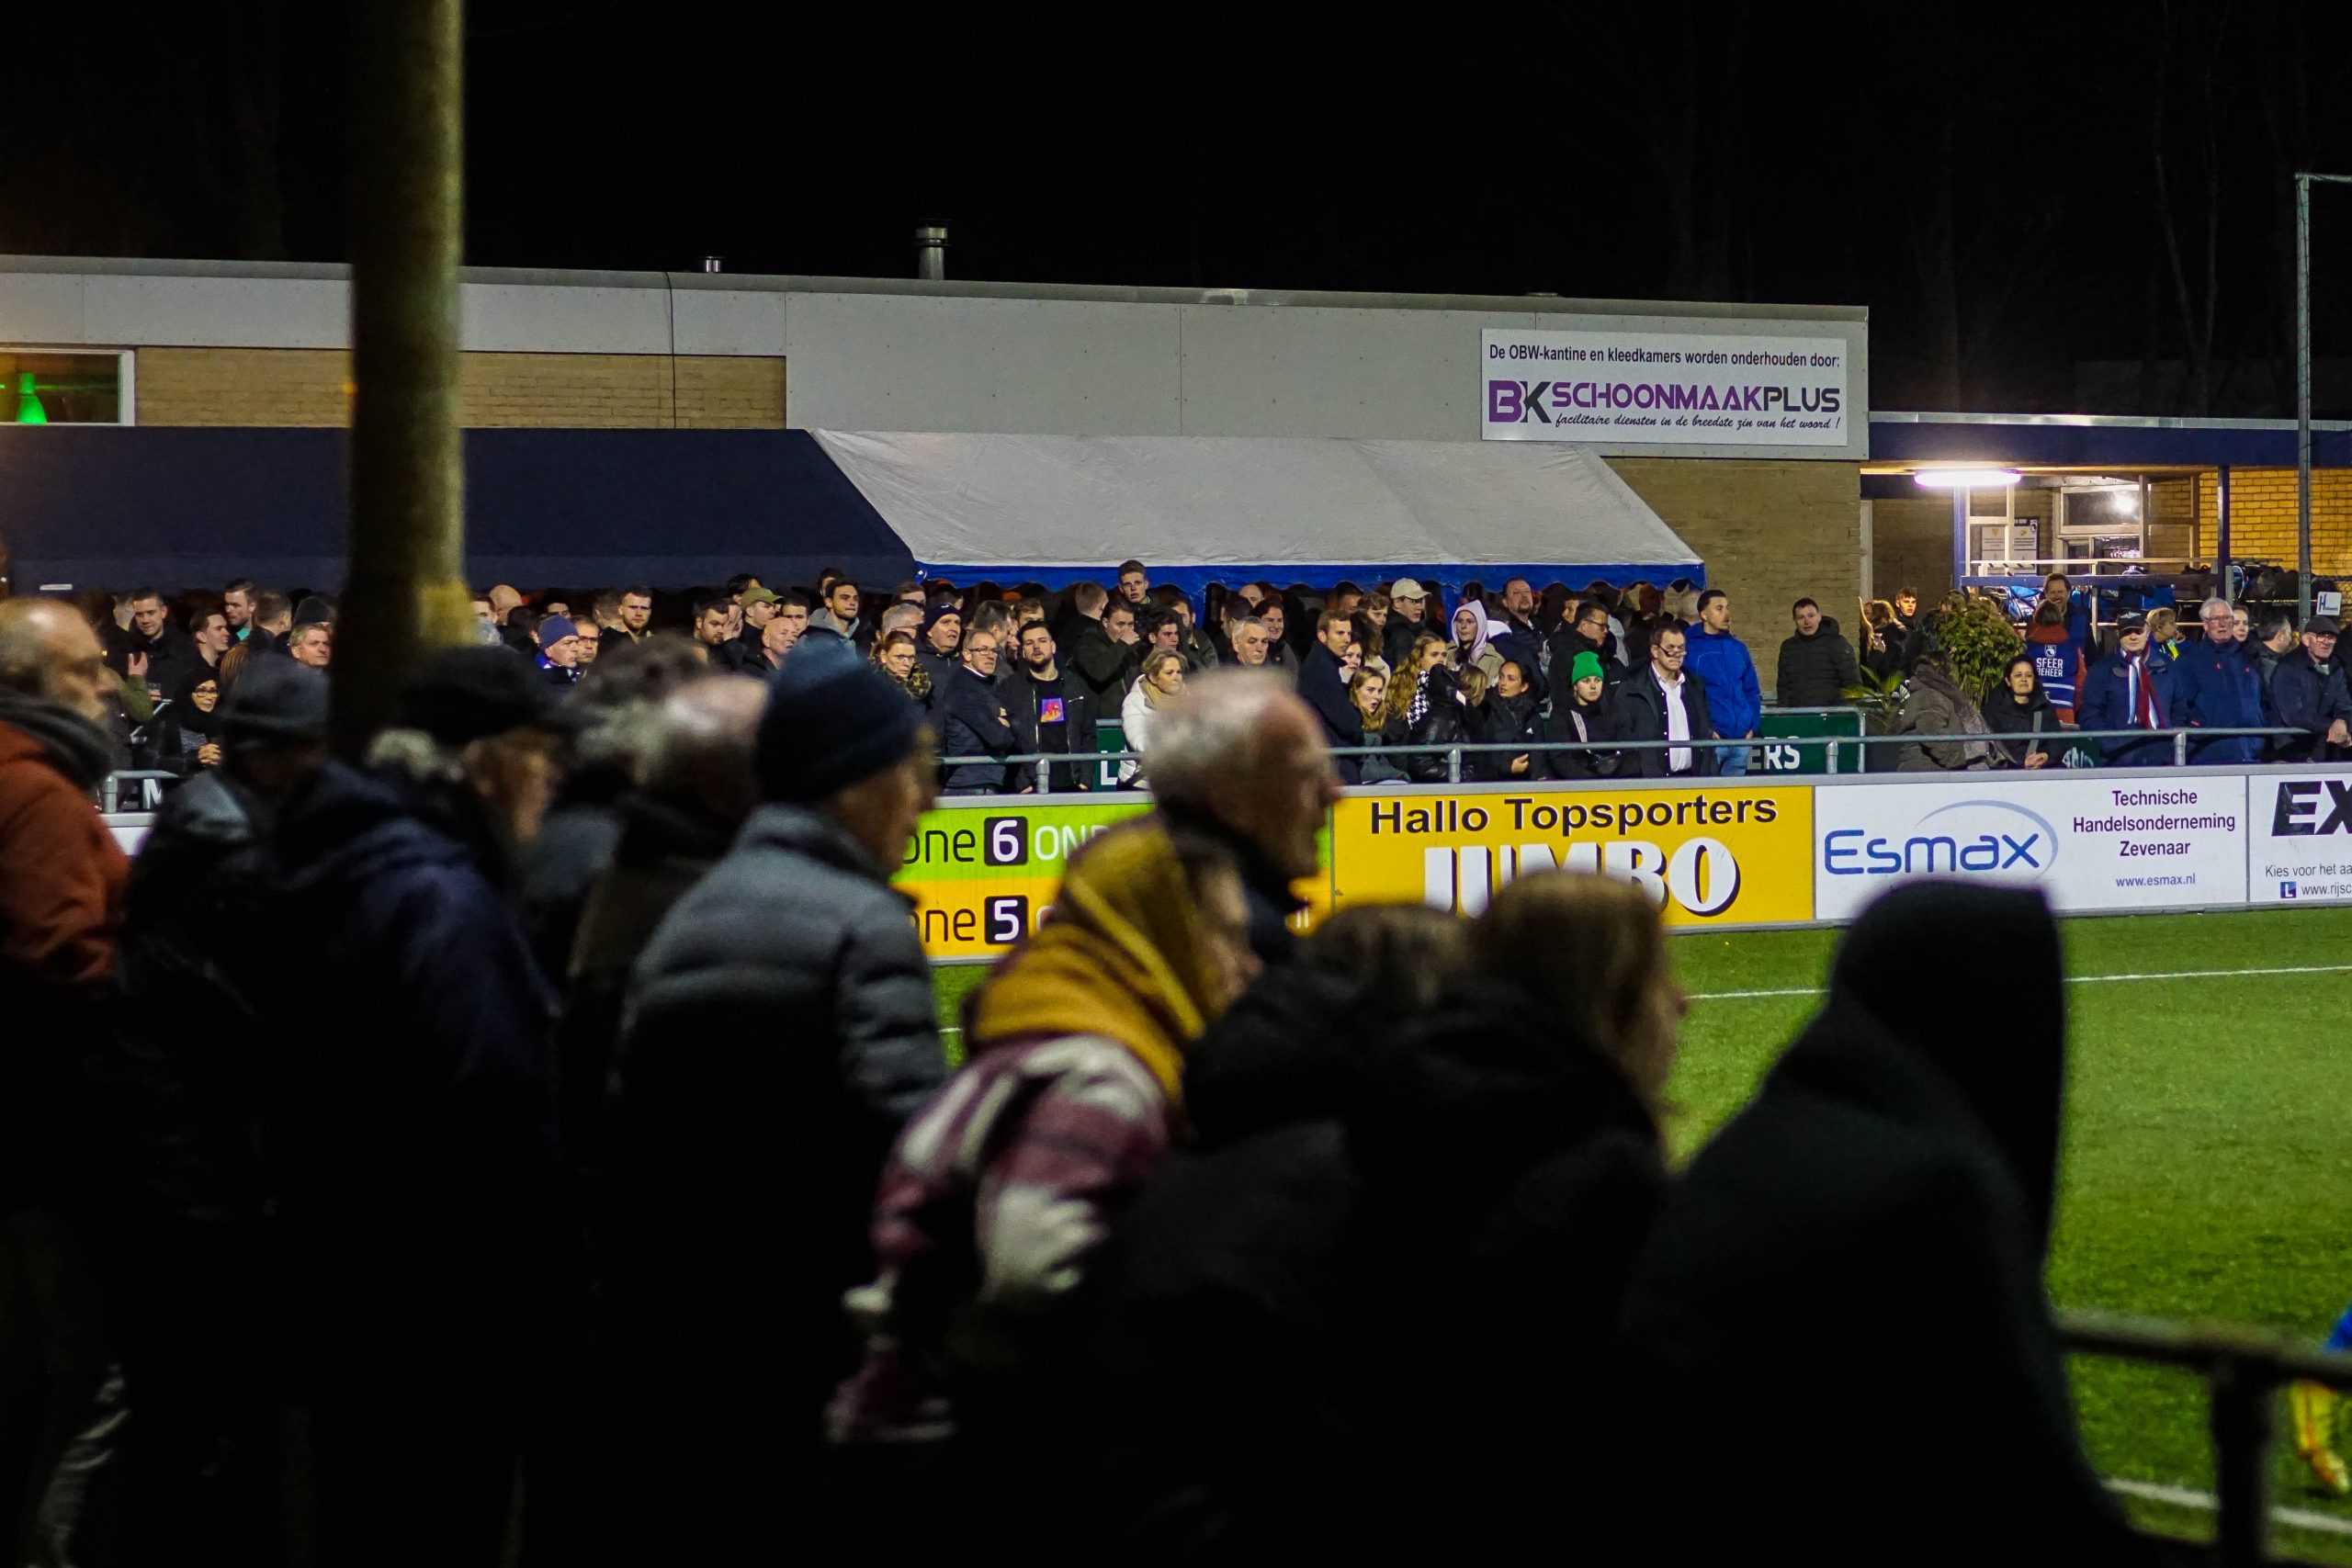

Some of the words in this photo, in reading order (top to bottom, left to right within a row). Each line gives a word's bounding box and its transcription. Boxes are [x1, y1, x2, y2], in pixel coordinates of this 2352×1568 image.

[1489, 344, 1505, 359] De
[1509, 344, 1586, 361] OBW-kantine
[1589, 350, 1604, 362] en
[1608, 346, 1681, 364] kleedkamers
[1685, 350, 1727, 365] worden
[1731, 351, 1807, 367] onderhouden
[1810, 353, 1839, 367] door:
[1555, 412, 1610, 427] facilitaire
[1613, 414, 1657, 425] diensten
[1660, 418, 1670, 426] in
[1675, 415, 1688, 426] de
[1691, 415, 1733, 427] breedste
[1736, 419, 1753, 431] zin
[1780, 417, 1795, 428] het
[1799, 417, 1830, 429] woord
[2036, 657, 2064, 669] SFEER
[2112, 788, 2198, 807] Technische
[1371, 801, 1488, 835] Hallo
[1504, 795, 1779, 837] Topsporters
[2073, 813, 2235, 833] Handelsonderneming
[992, 819, 1019, 863] 6
[1034, 825, 1110, 861] ON
[2120, 840, 2190, 857] Zevenaar
[1824, 829, 2040, 874] Esmax
[2266, 865, 2290, 877] Kies
[2292, 865, 2316, 876] voor
[2319, 863, 2337, 874] het
[2116, 874, 2196, 888] www.esmax.nl
[908, 908, 976, 943] ne
[994, 899, 1020, 942] 5
